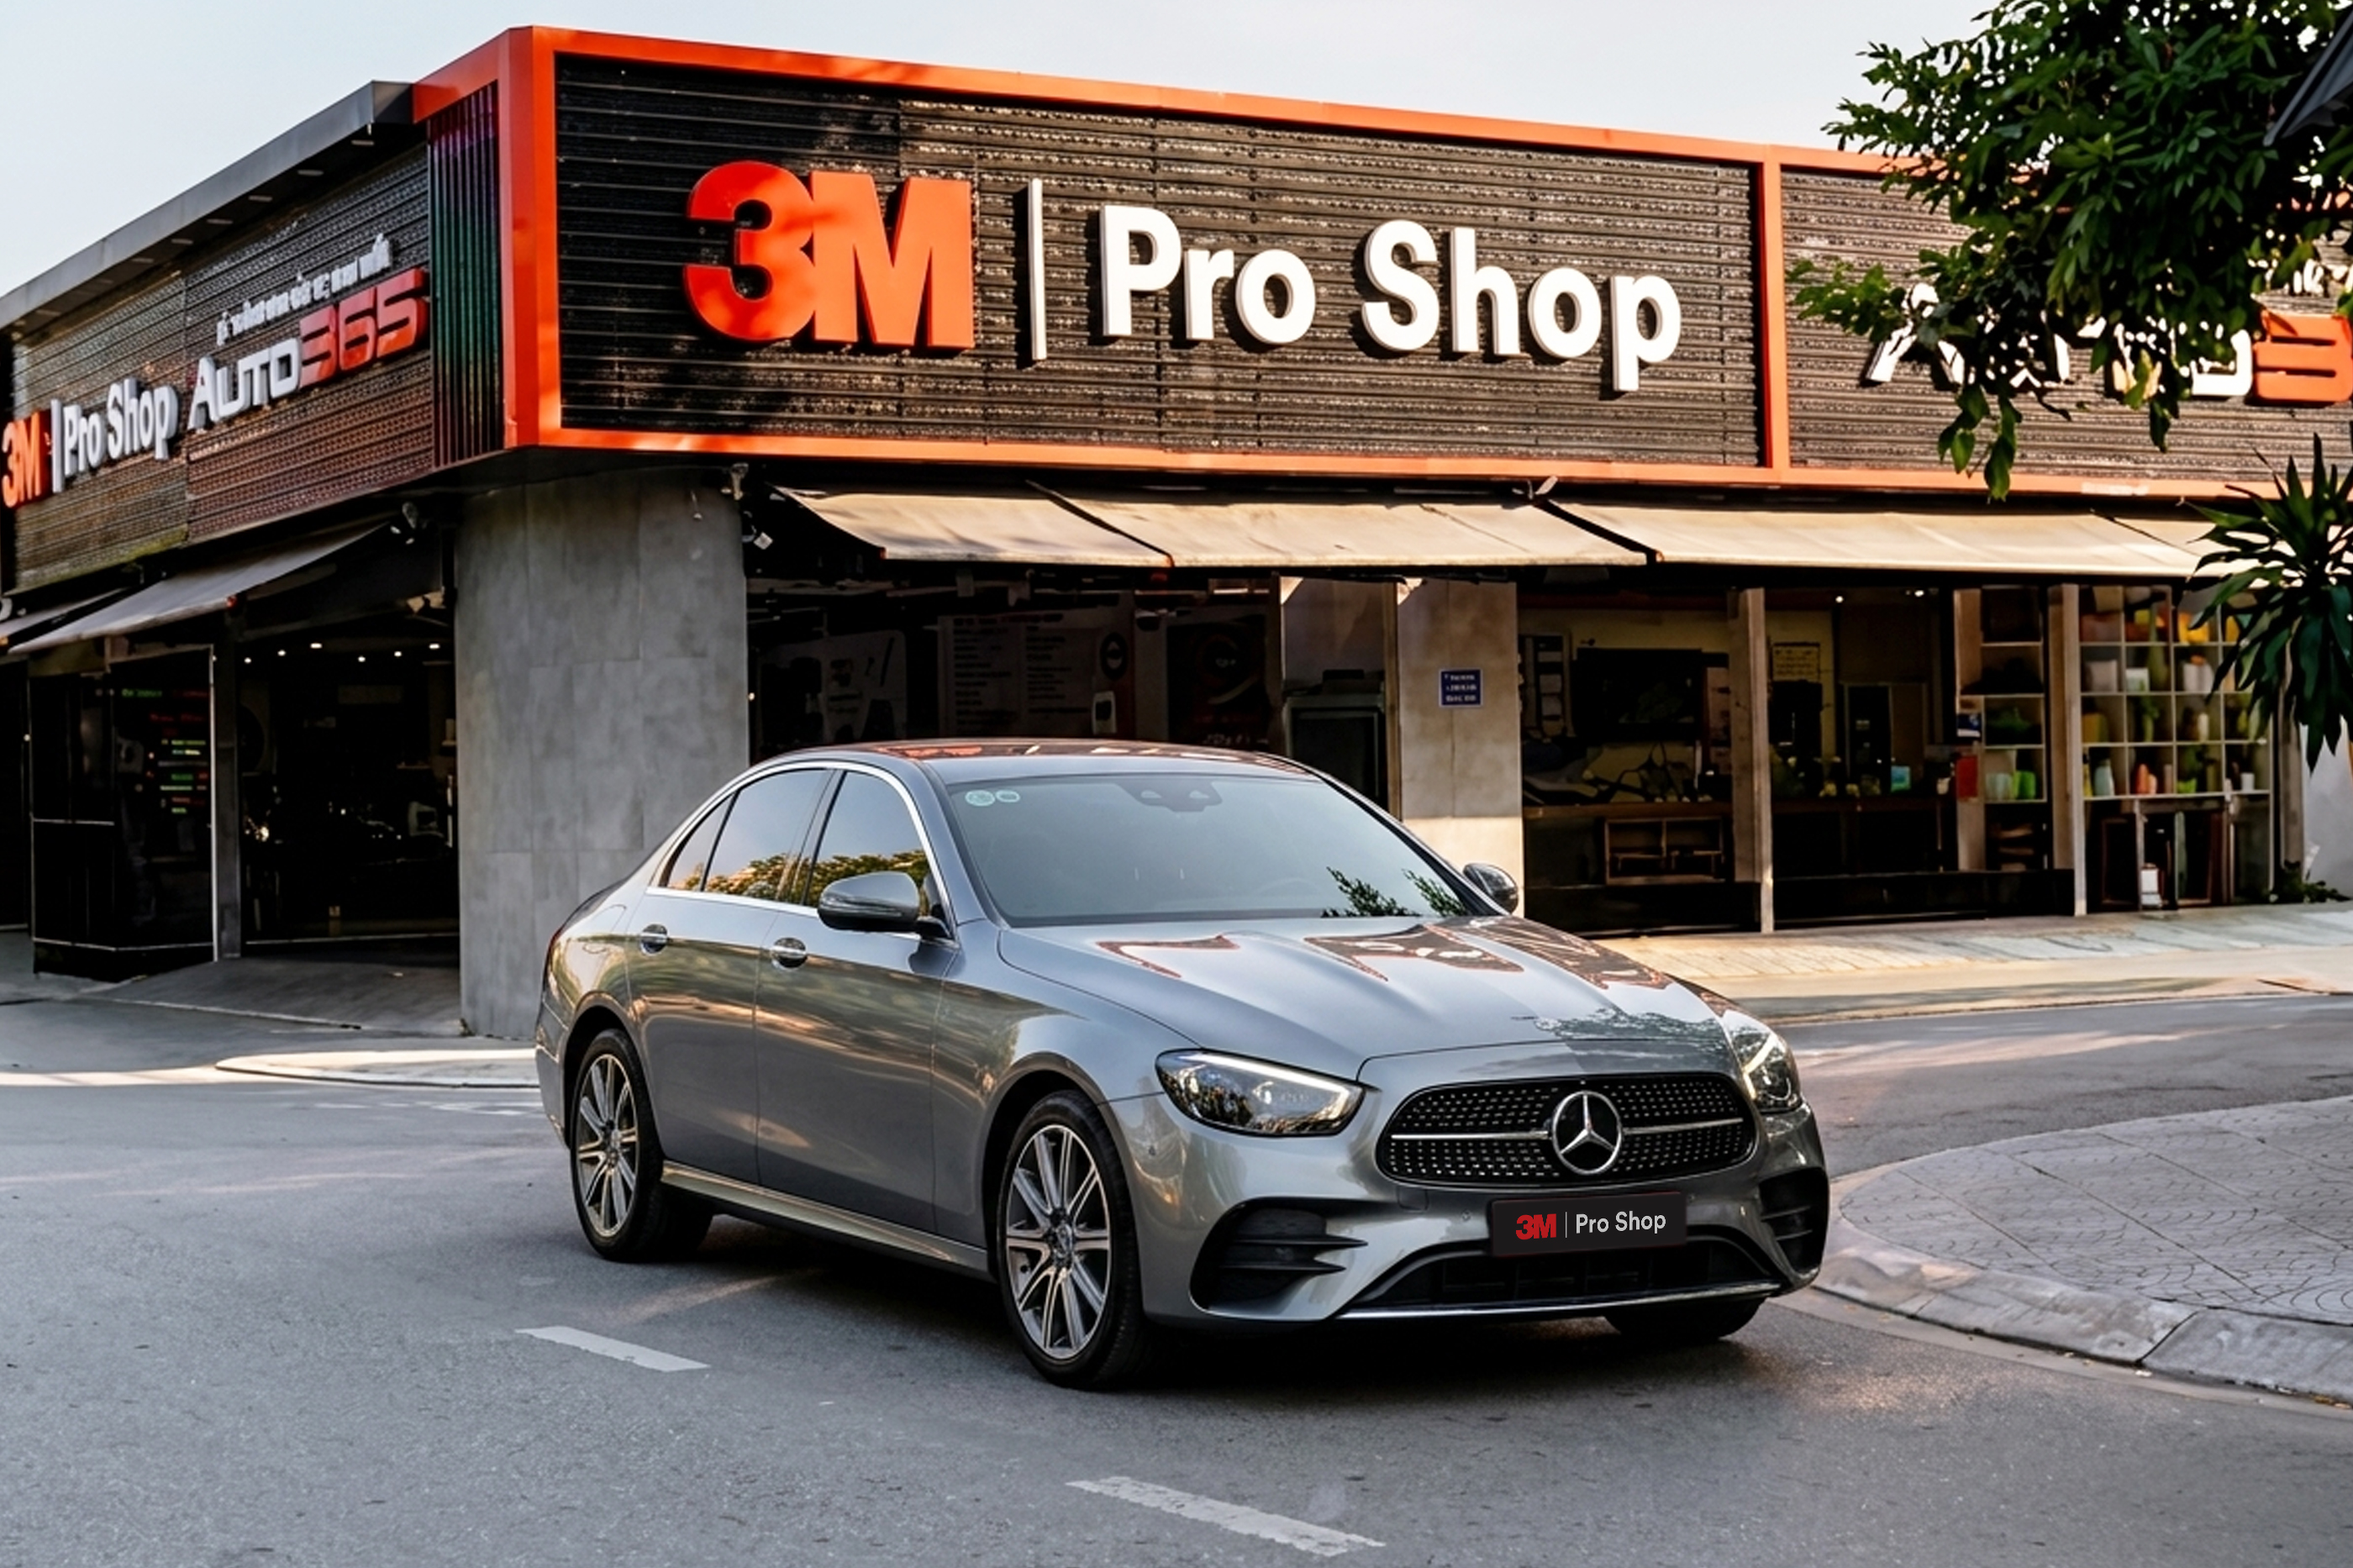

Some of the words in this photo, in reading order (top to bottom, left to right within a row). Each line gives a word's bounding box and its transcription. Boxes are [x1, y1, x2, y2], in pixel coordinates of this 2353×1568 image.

[683, 160, 976, 349] 3M
[1098, 205, 1317, 345] Pro
[1361, 219, 1682, 392] Shop
[2, 407, 50, 508] 3M
[63, 403, 105, 477] Pro
[107, 377, 179, 460] Shop
[1515, 1213, 1557, 1240] 3M
[1576, 1213, 1609, 1234] Pro
[1614, 1210, 1666, 1234] Shop
